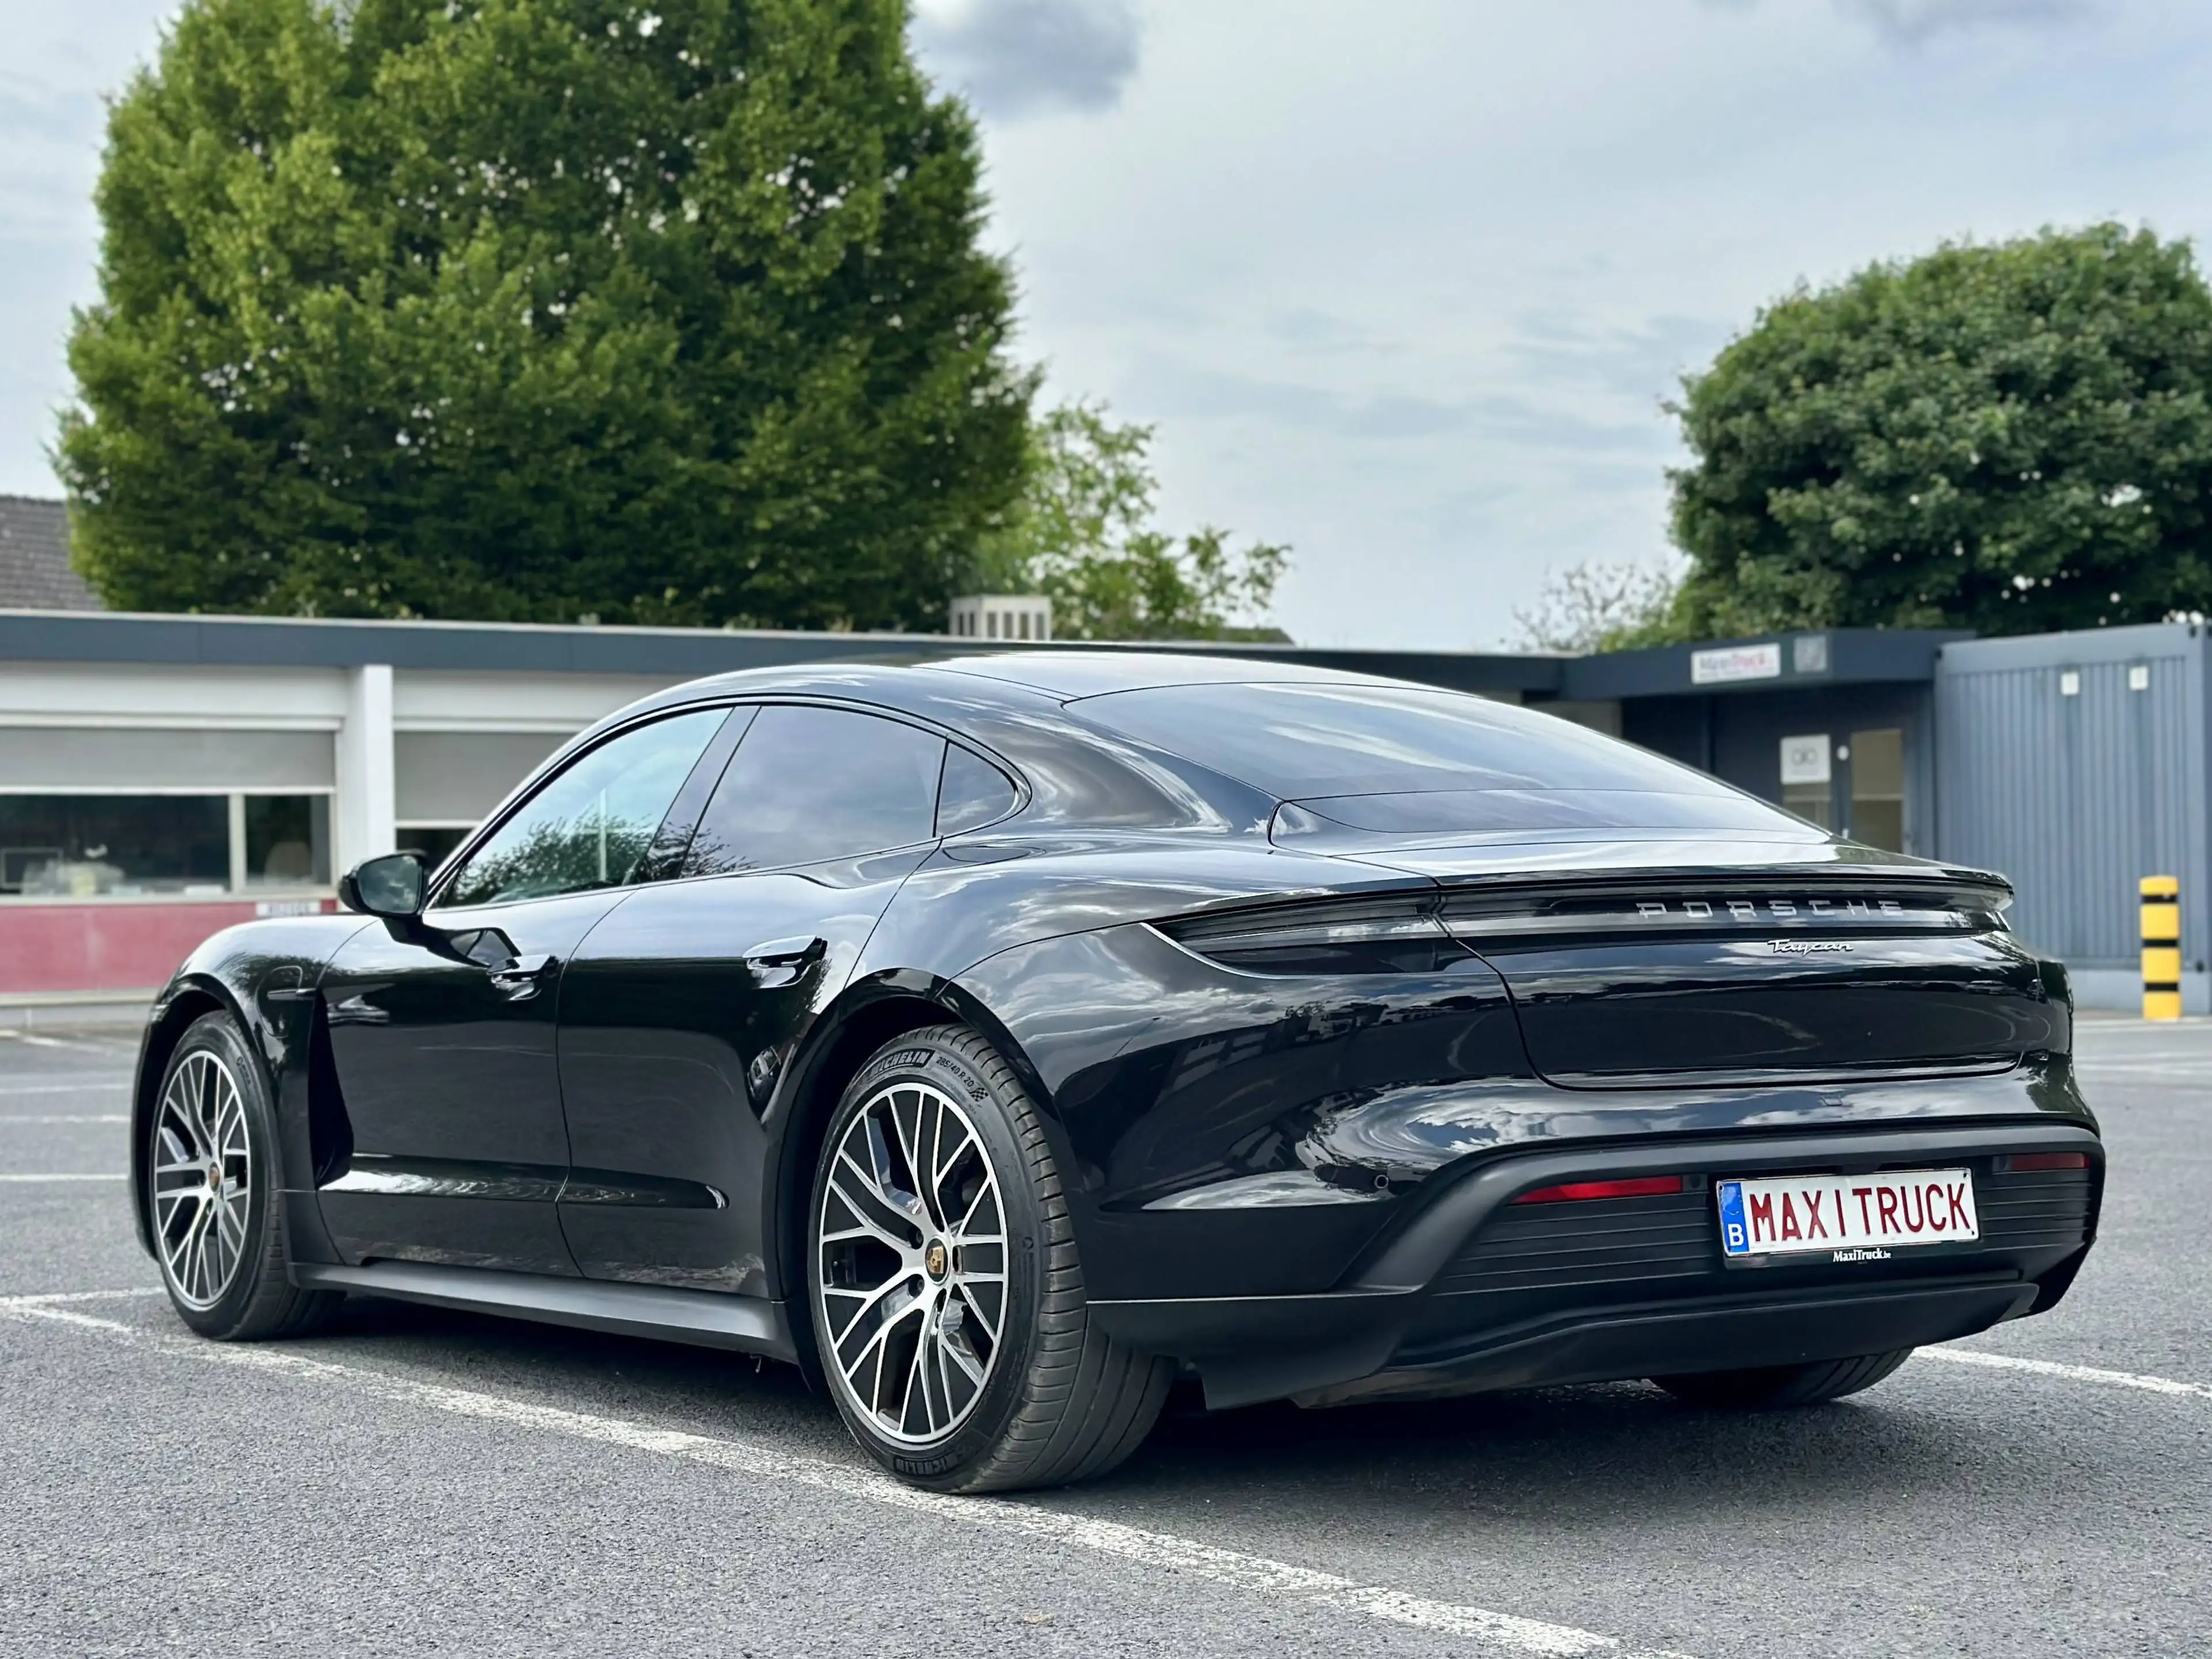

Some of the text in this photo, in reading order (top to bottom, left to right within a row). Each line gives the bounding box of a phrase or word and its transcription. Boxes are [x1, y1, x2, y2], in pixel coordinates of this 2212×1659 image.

[1635, 900, 1904, 919] PORSCHE
[1767, 939, 1854, 957] Taycan
[936, 1056, 974, 1087] 285/40 R 20
[1727, 1222, 1744, 1247] B
